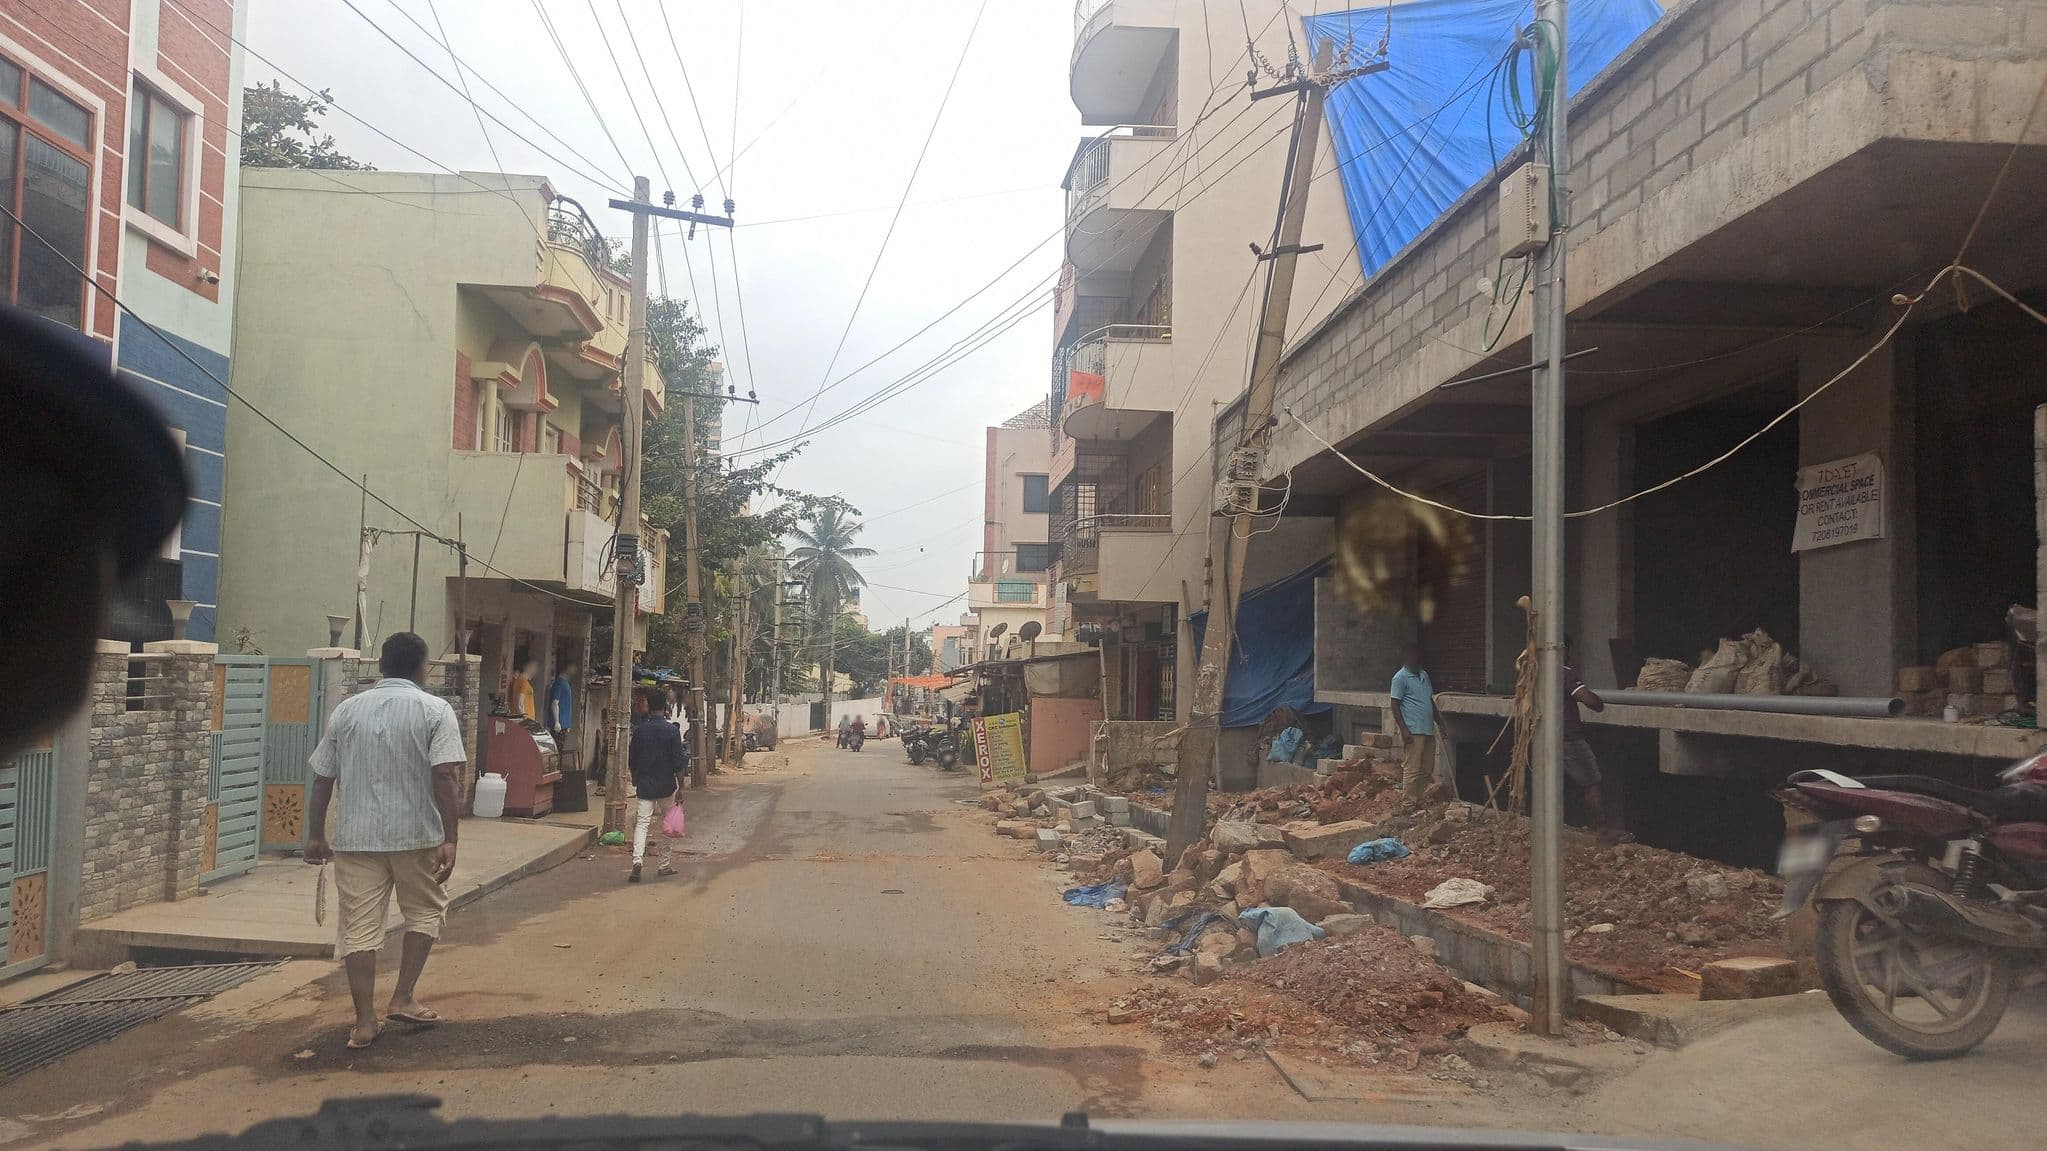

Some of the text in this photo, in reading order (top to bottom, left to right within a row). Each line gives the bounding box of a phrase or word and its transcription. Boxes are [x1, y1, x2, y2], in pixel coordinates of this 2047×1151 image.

[1801, 474, 1875, 501] OMMERCIAL SPACE
[1800, 489, 1879, 516] OR RENT AVAILABLE
[975, 720, 991, 780] XEROX
